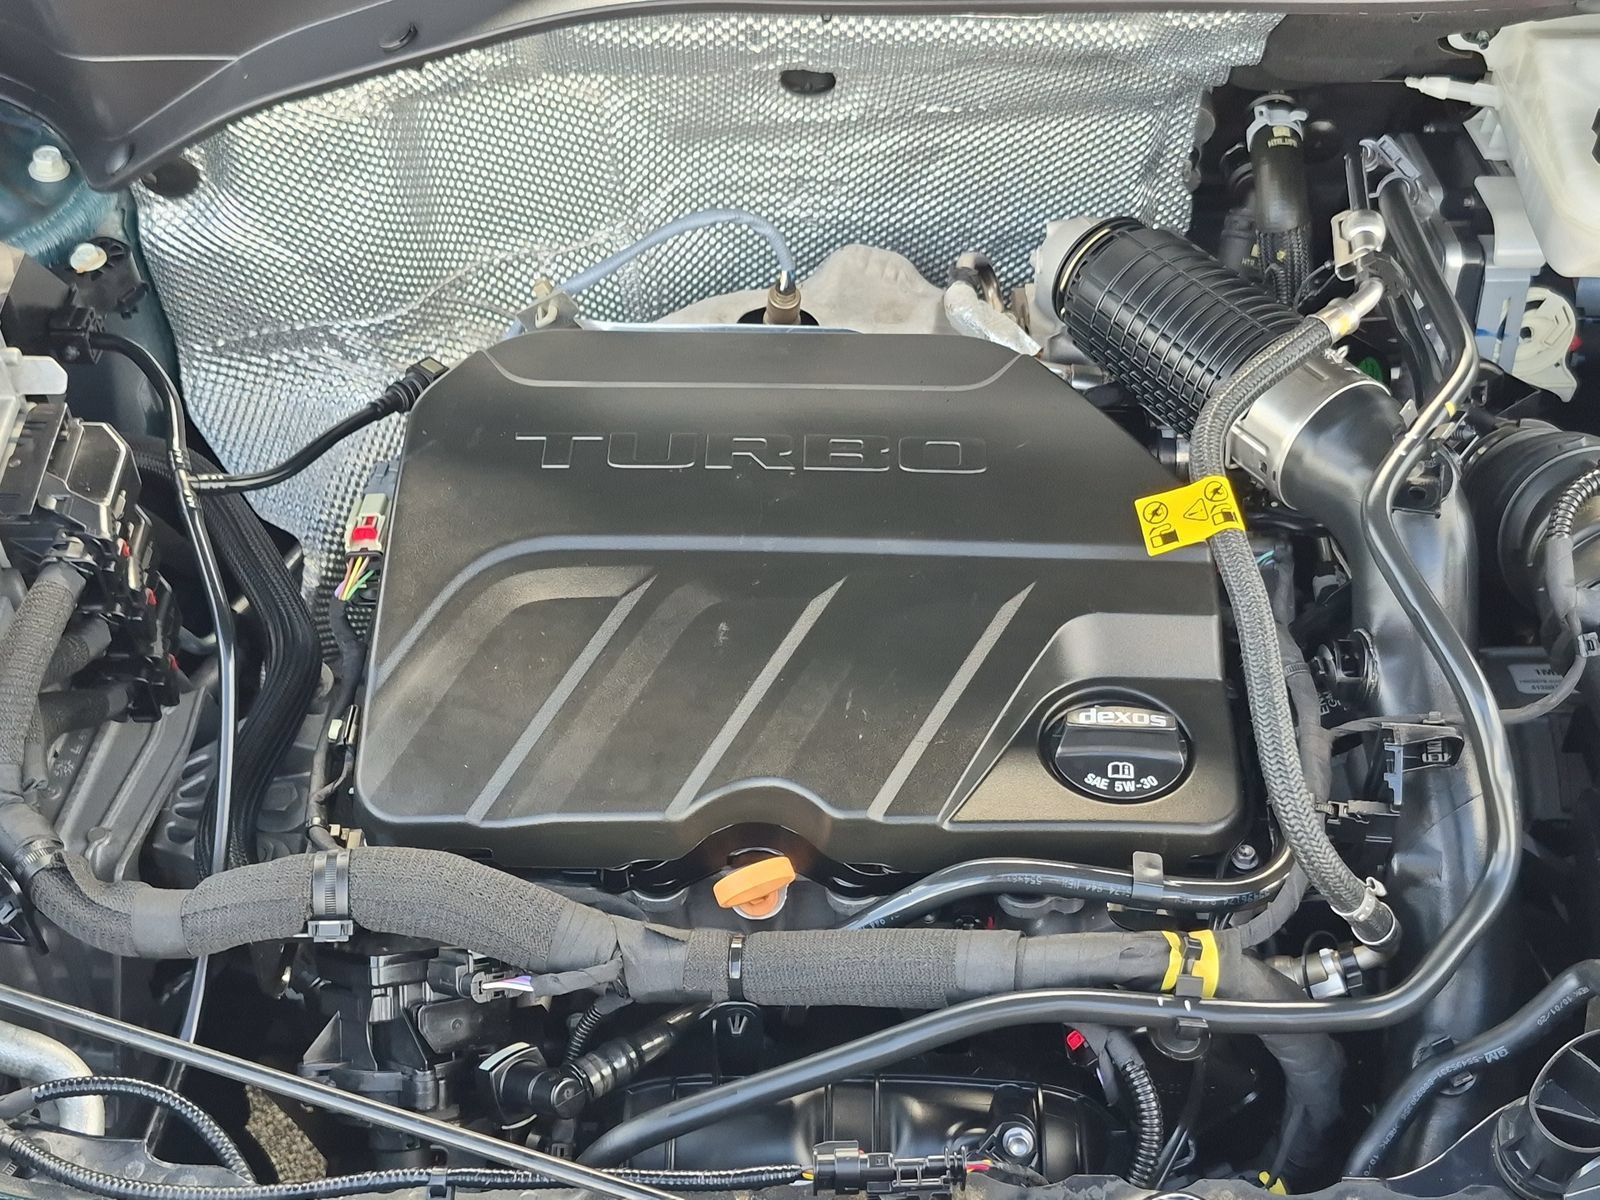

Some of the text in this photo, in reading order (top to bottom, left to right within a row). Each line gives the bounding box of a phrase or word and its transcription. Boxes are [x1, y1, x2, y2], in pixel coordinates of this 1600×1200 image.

[515, 432, 988, 474] TURBO
[1078, 707, 1168, 728] dexos
[1083, 772, 1159, 792] SAE 5W-30
